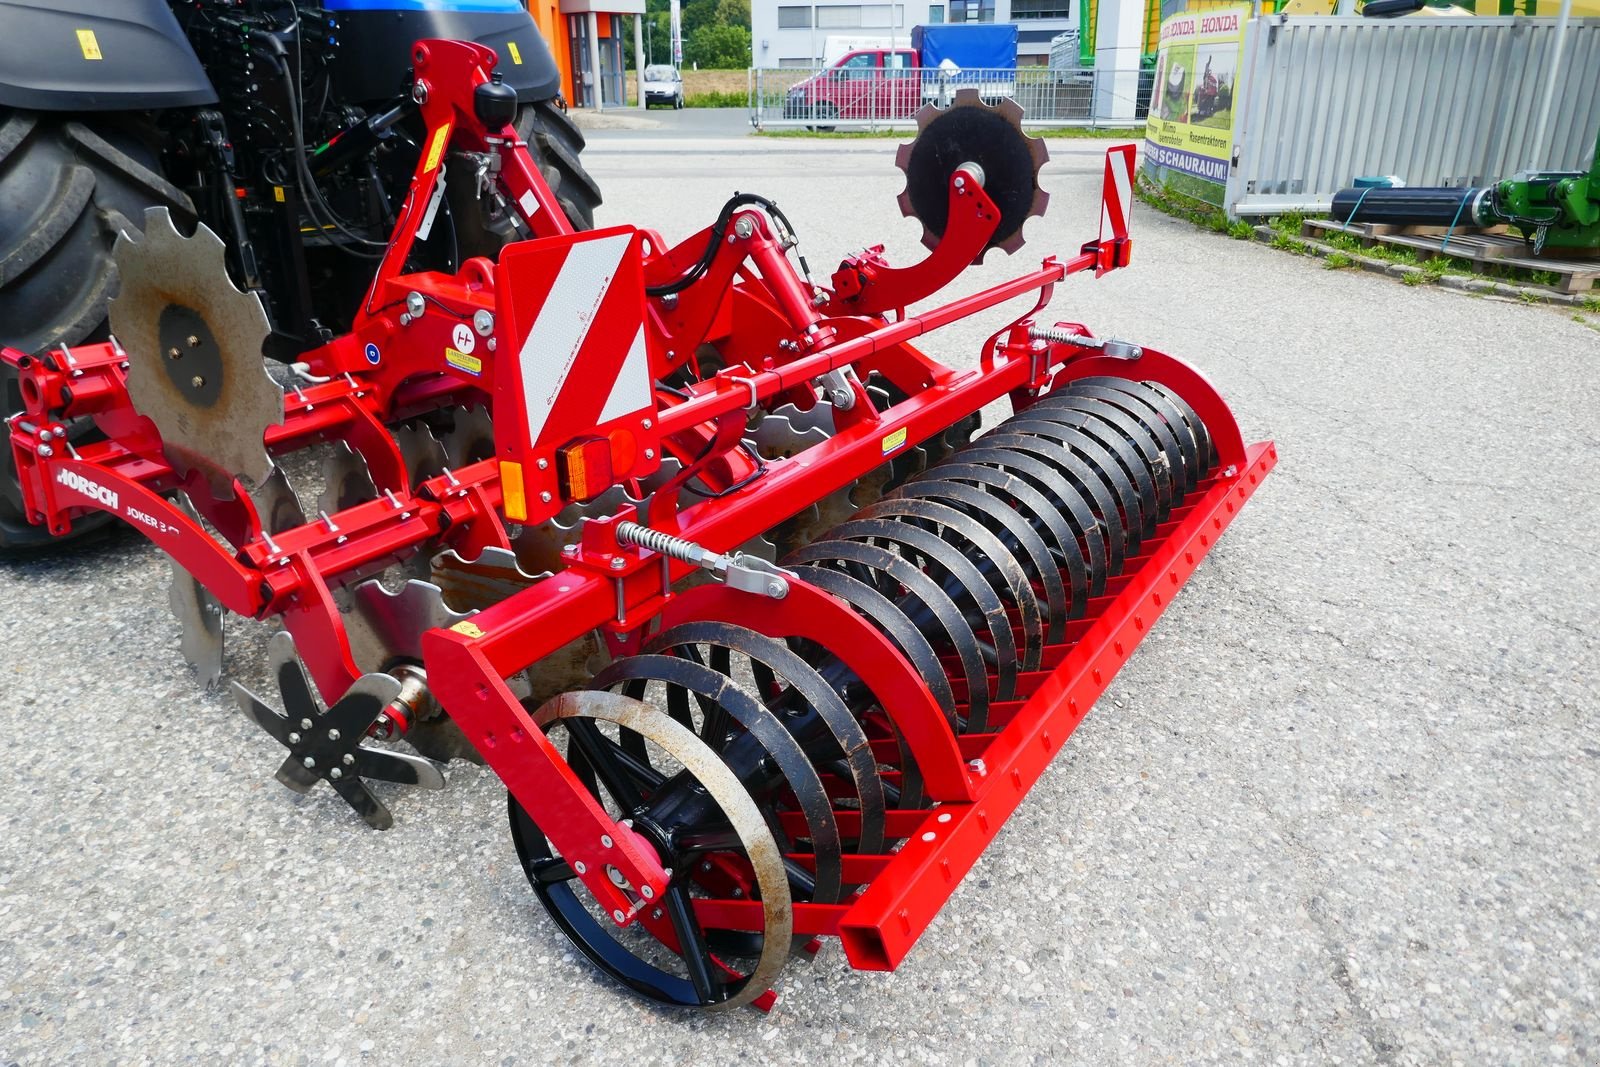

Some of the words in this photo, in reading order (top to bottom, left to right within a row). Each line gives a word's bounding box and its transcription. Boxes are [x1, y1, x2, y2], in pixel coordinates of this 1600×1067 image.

[1171, 20, 1195, 37] ONDA
[1200, 15, 1238, 33] HONDA
[1189, 131, 1227, 149] Rasentraktoren
[1159, 149, 1228, 180] SCHAURAUM!
[126, 506, 158, 529] JOKER
